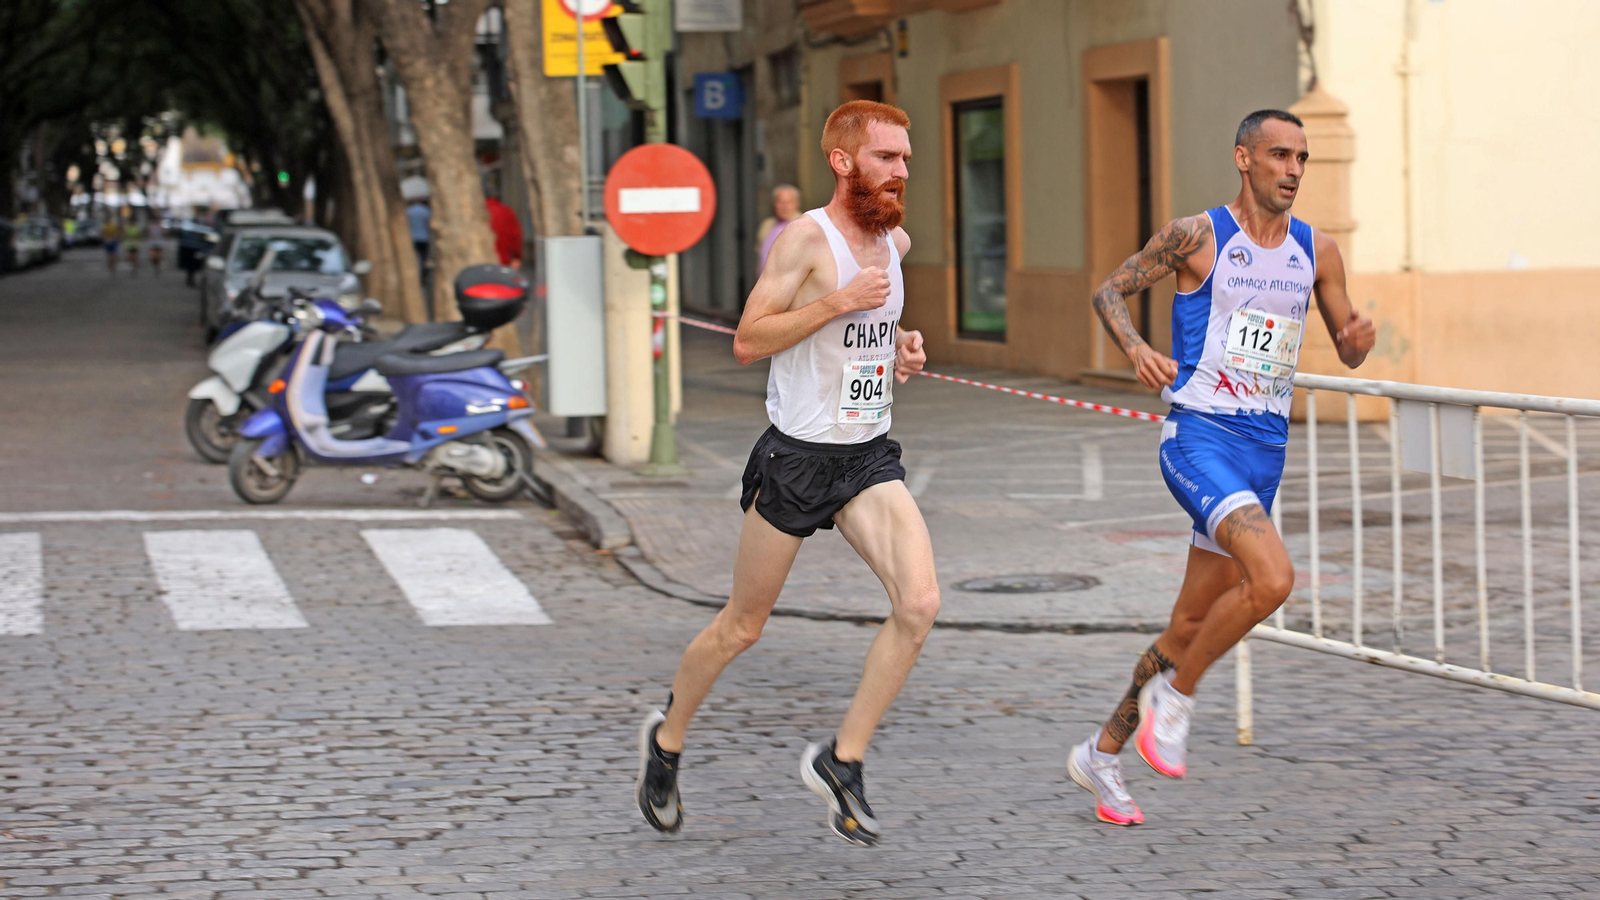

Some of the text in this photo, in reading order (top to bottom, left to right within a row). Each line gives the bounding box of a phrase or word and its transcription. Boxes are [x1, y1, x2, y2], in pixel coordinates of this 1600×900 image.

[704, 80, 726, 110] B
[1269, 279, 1310, 296] ATLETISMO
[1239, 326, 1272, 352] 112
[850, 379, 883, 401] 904
